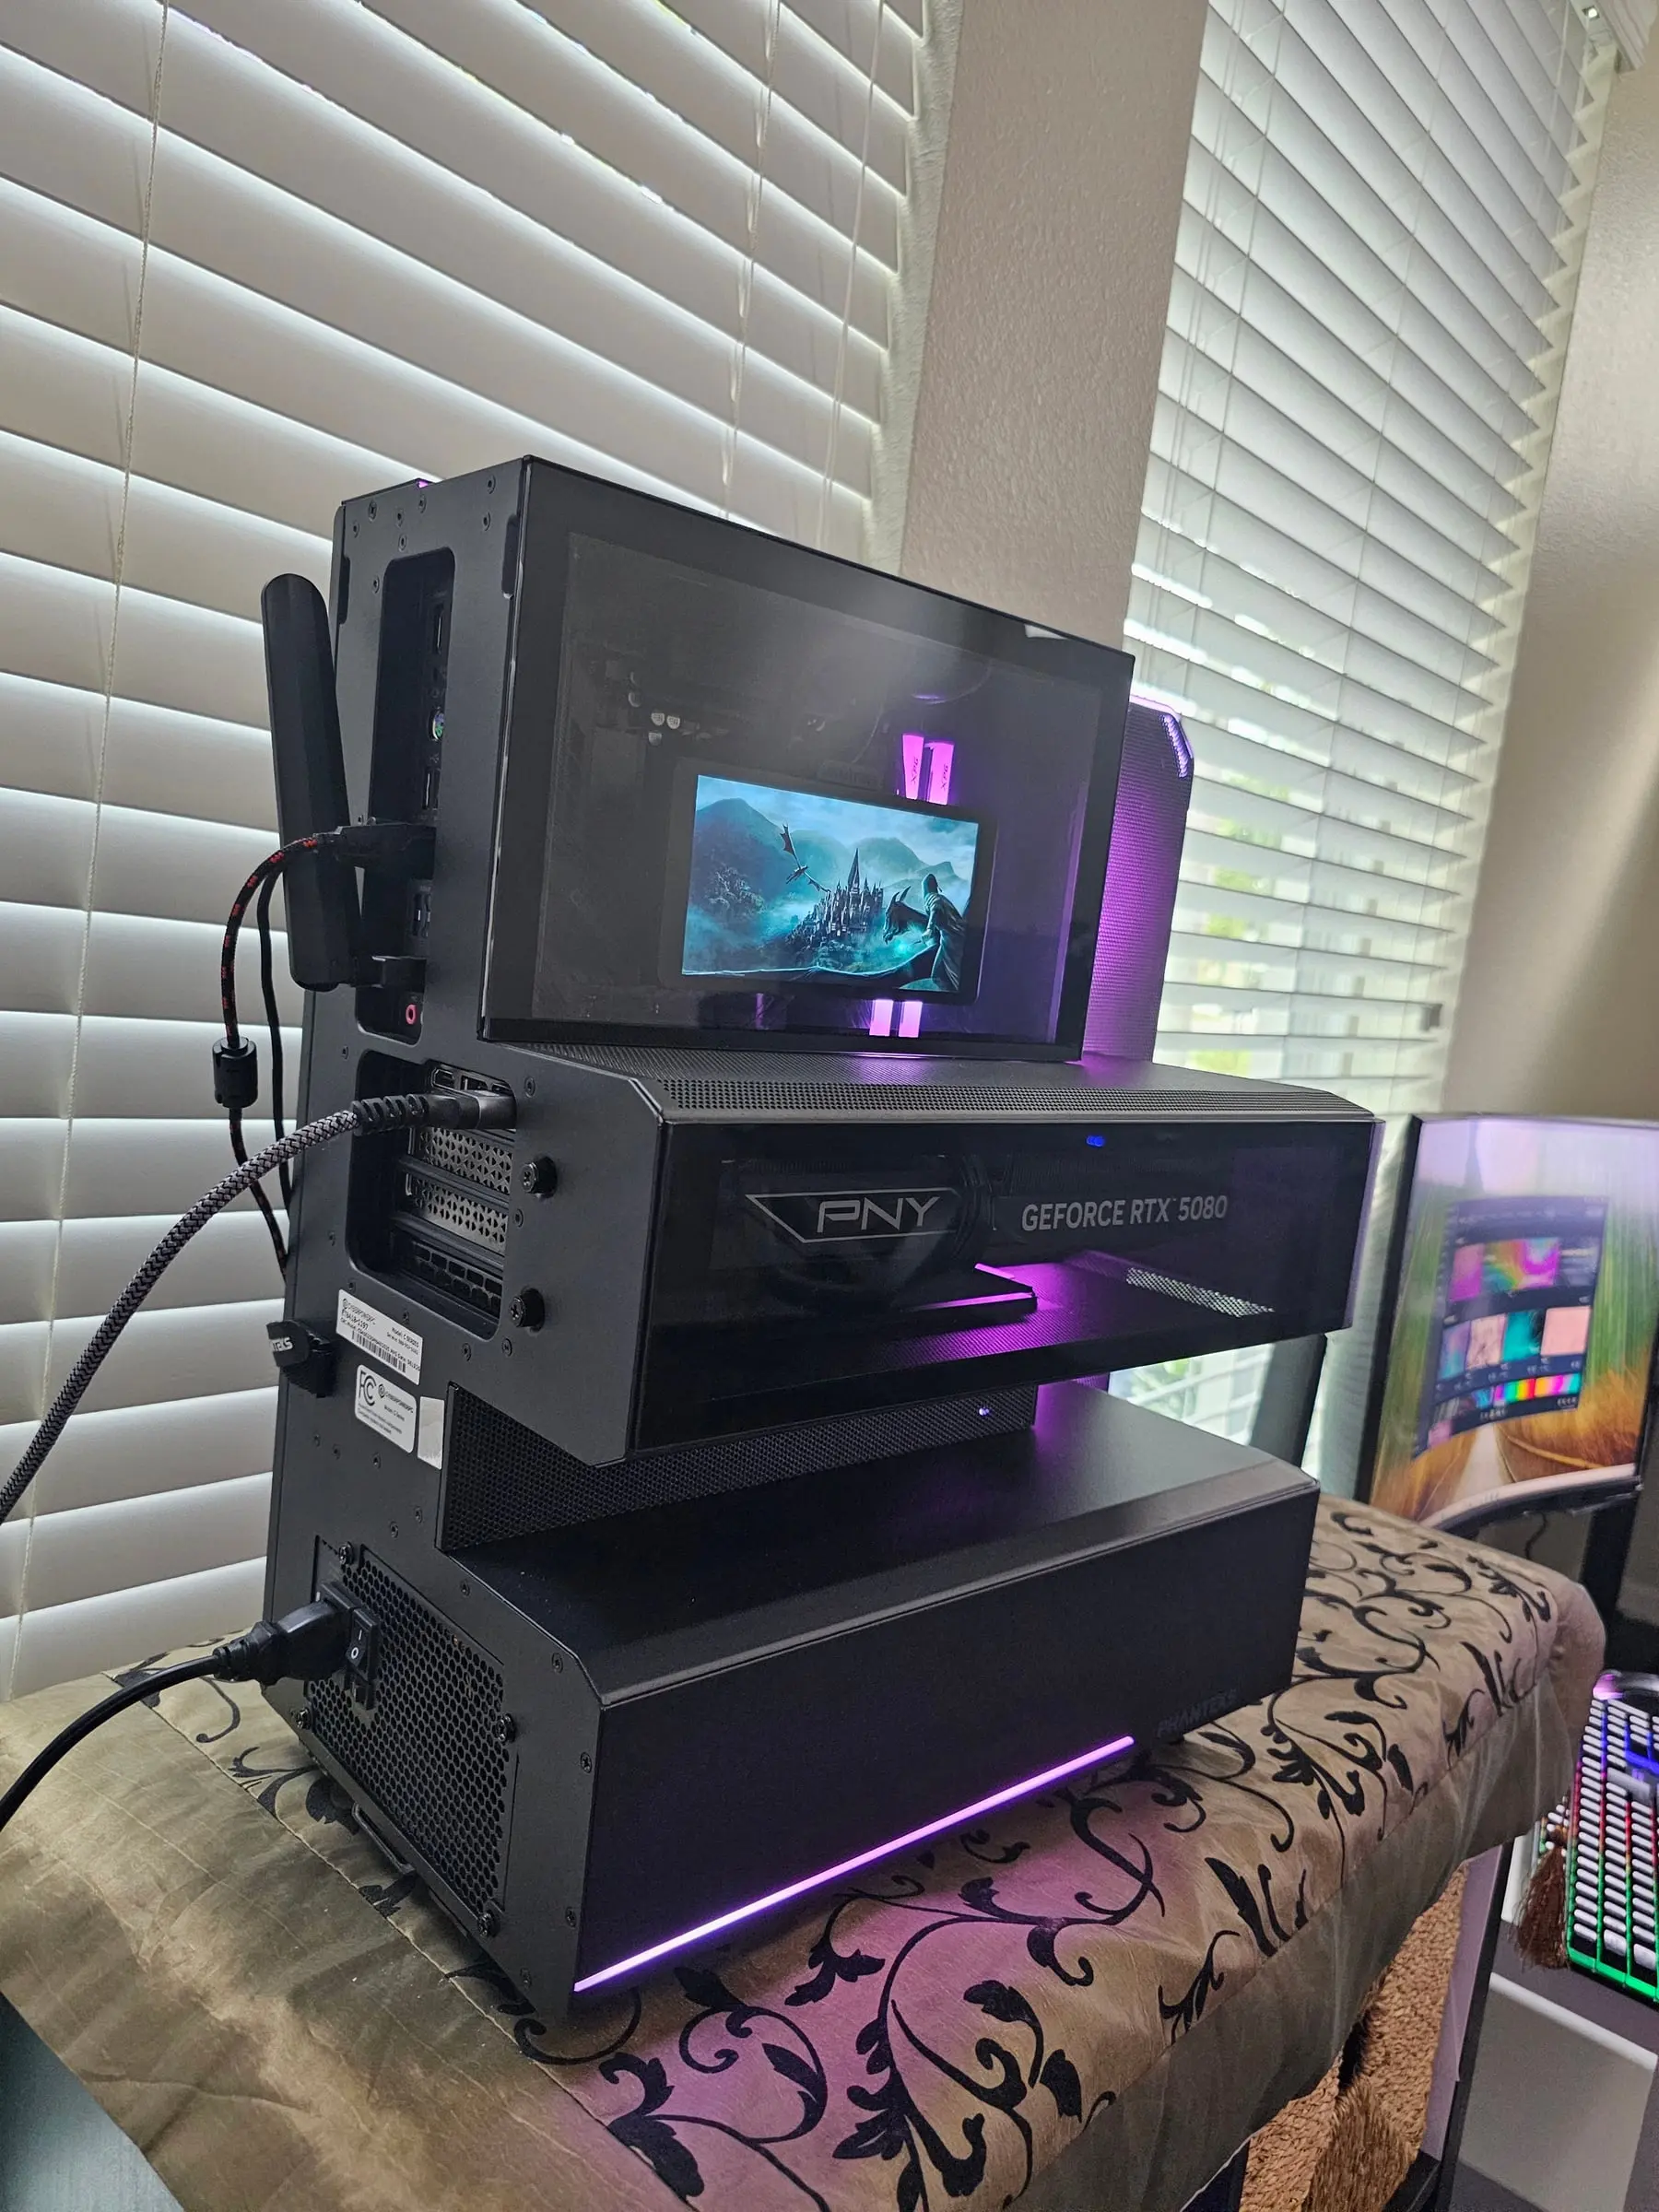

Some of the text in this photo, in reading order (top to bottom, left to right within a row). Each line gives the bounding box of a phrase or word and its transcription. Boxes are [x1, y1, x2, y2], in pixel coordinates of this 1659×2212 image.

[910, 759, 919, 784] XPG
[940, 764, 948, 790] XPG
[817, 1196, 940, 1233] PNY
[1021, 1195, 1228, 1231] GEFORCE RTX 5080
